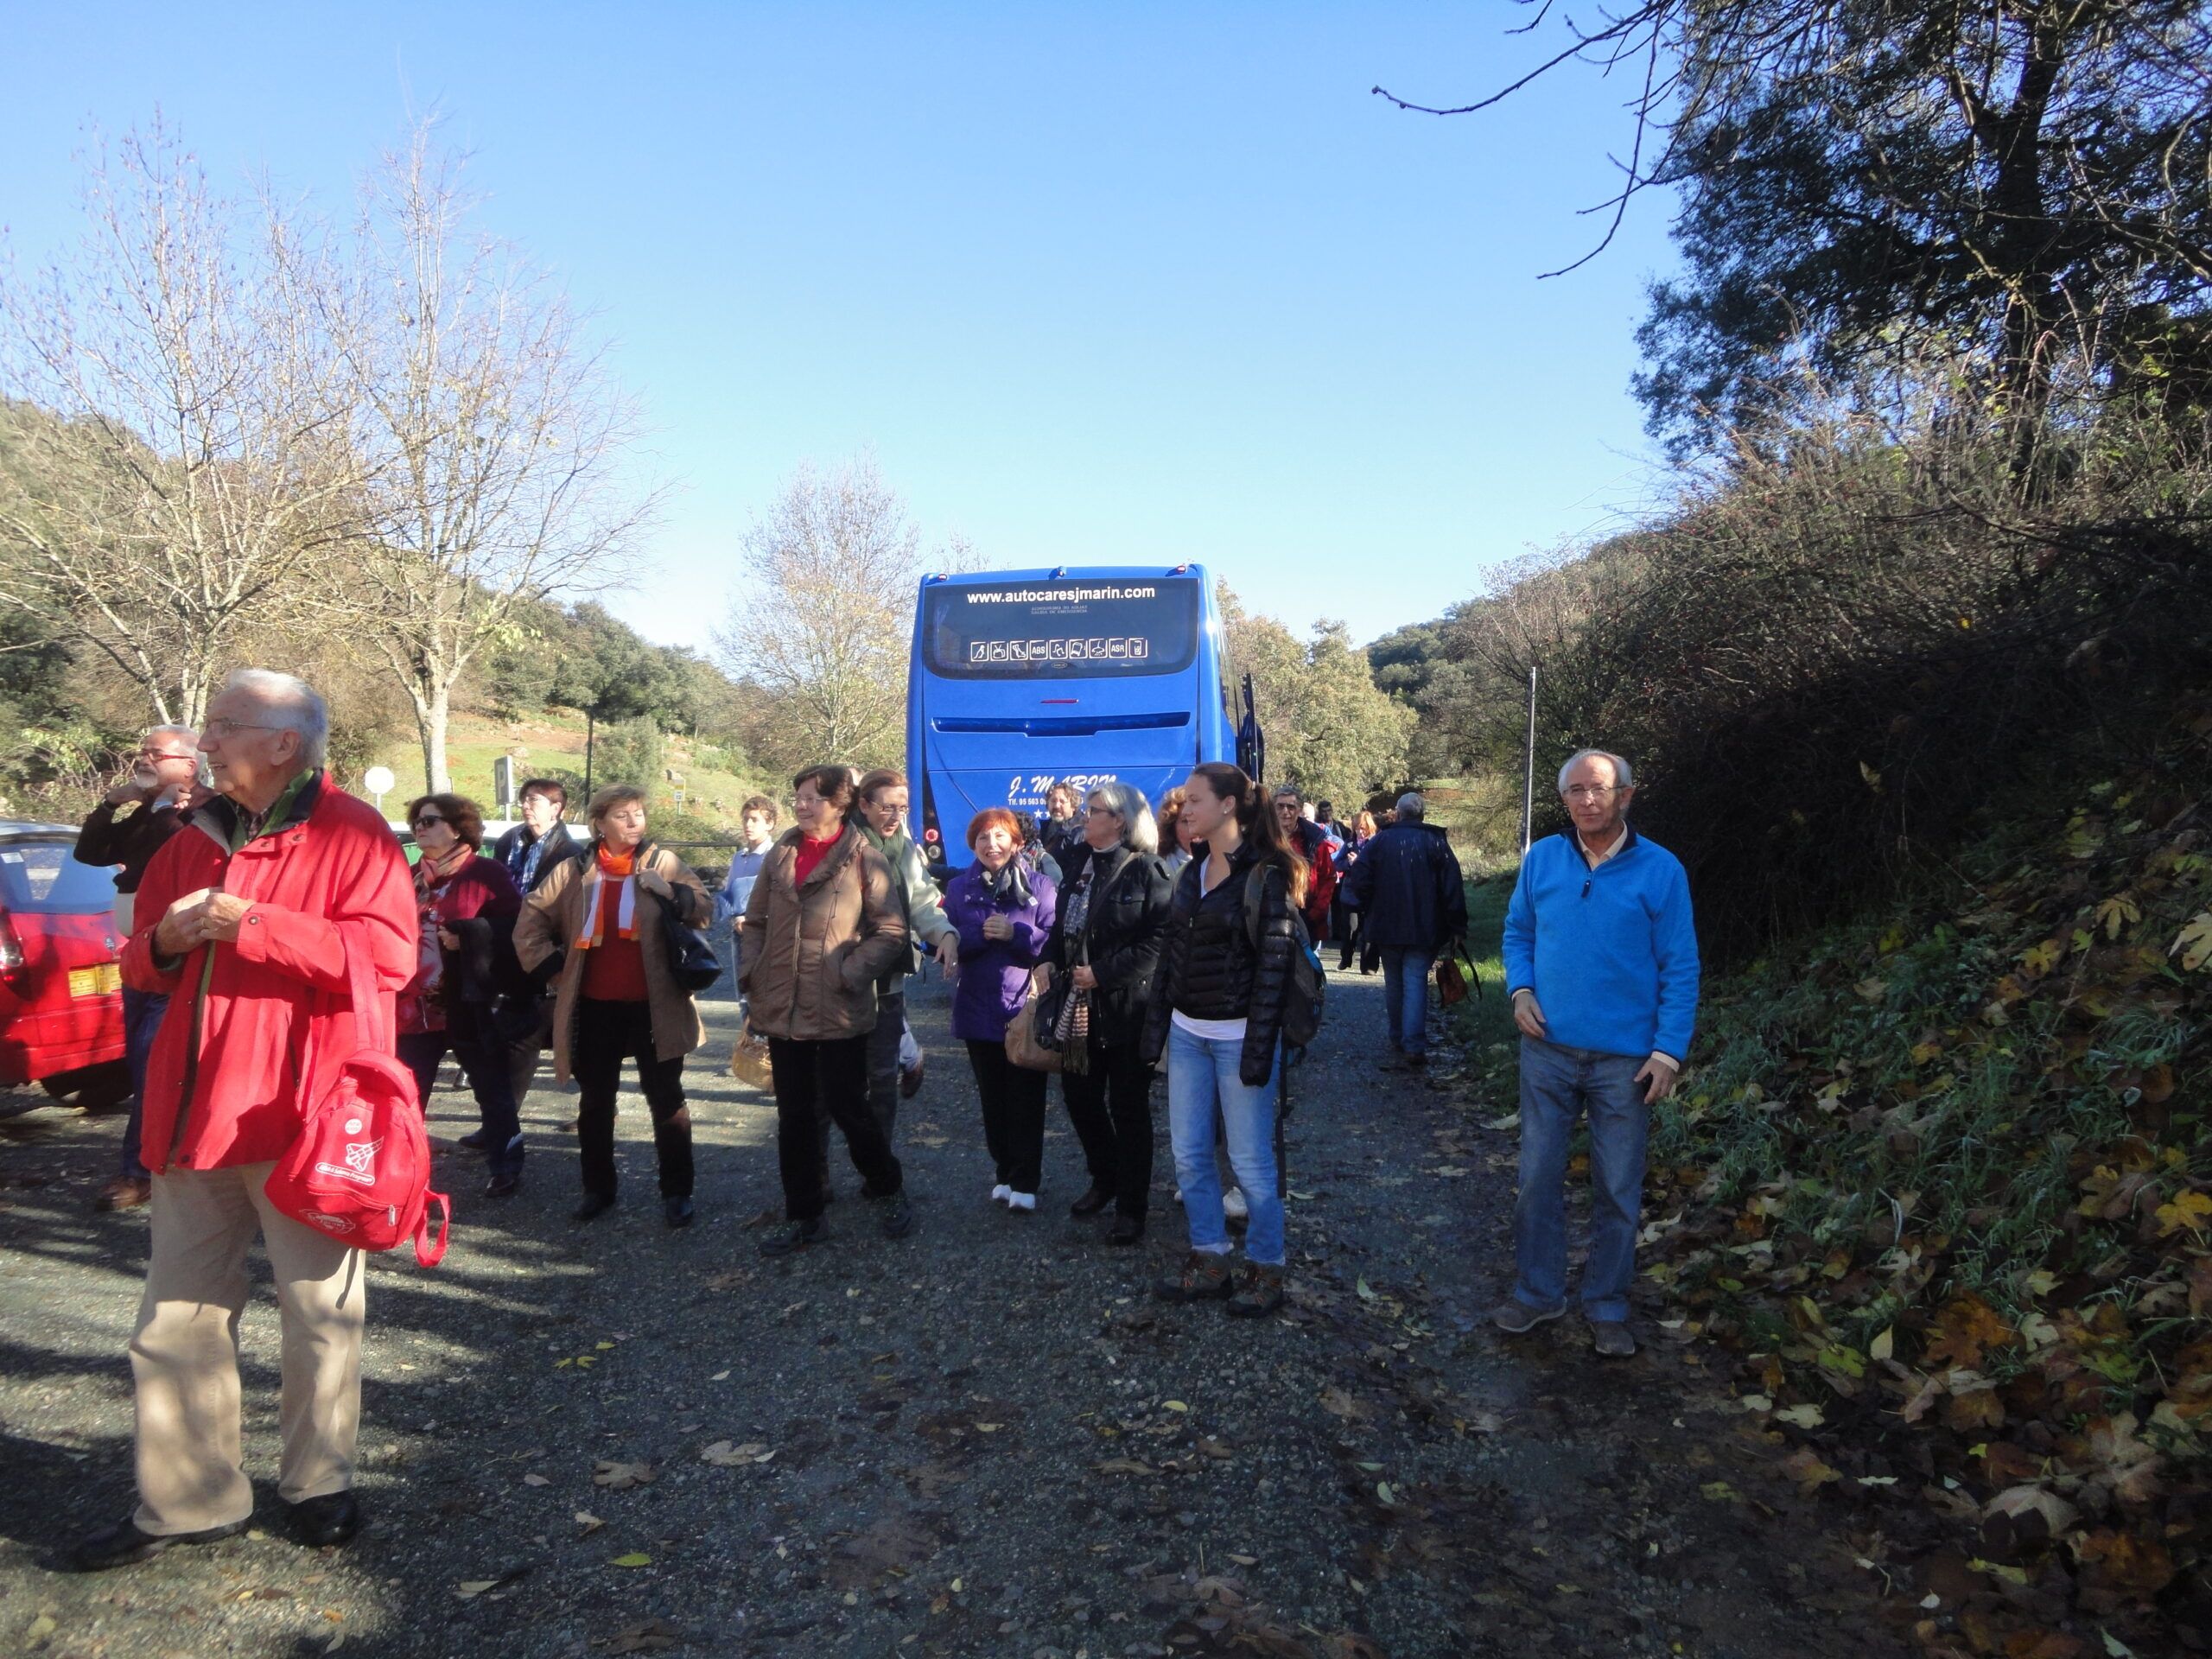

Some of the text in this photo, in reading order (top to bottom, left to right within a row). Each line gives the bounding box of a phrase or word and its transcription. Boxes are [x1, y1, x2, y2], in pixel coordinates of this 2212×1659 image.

[966, 586, 1155, 604] www.autocaresjmarin.com
[1032, 646, 1046, 655] ABS
[1111, 645, 1125, 653] ASR
[1007, 776, 1027, 798] J.
